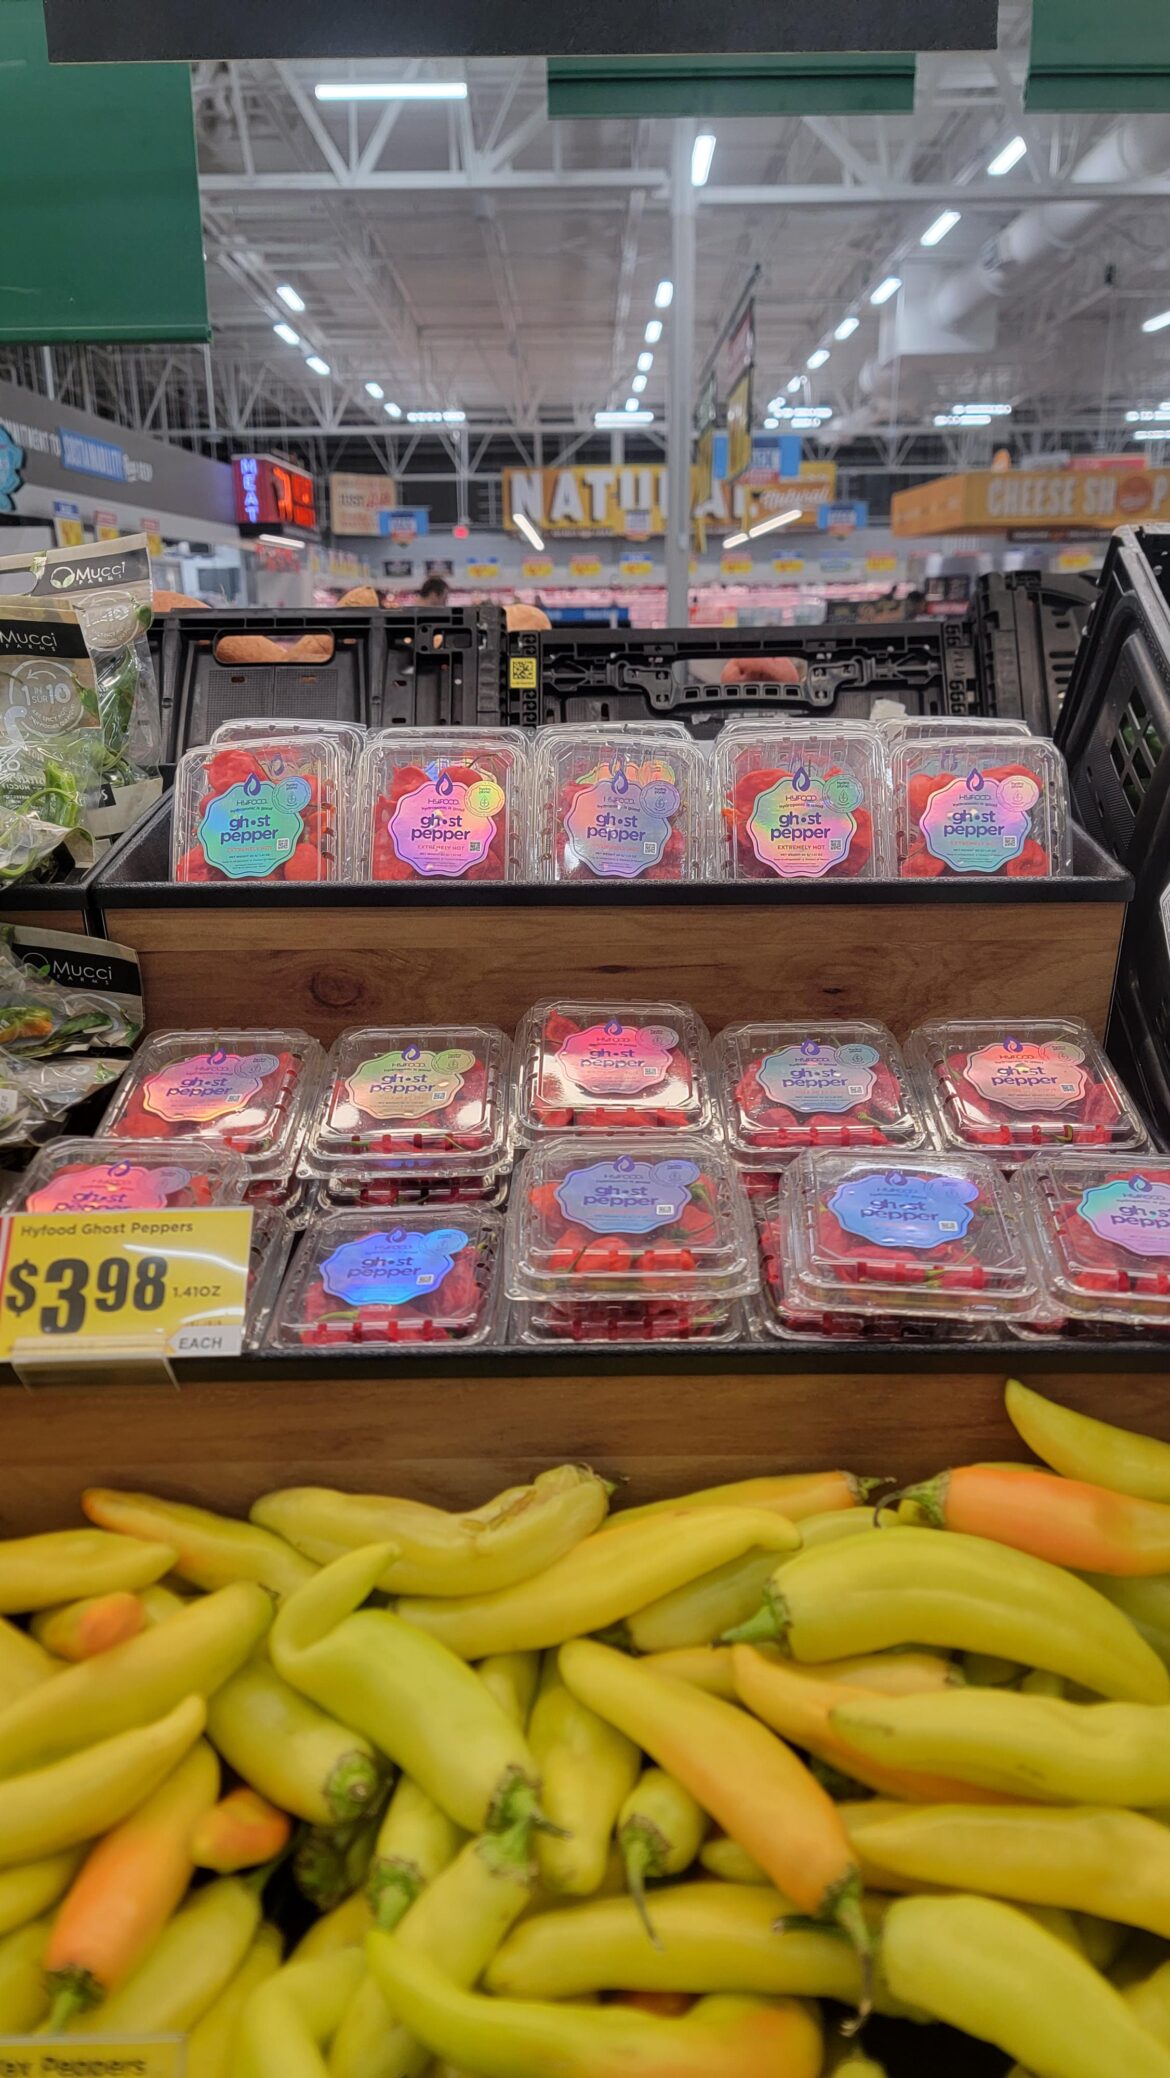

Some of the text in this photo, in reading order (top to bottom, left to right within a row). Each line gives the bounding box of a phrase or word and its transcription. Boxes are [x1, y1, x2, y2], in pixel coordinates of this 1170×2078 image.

[240, 457, 258, 523] MEAT
[988, 477, 1075, 516] CHEESE
[76, 561, 125, 580] Mucci
[0, 630, 57, 647] Mucci
[32, 695, 48, 704] SUR
[46, 683, 71, 704] 10
[220, 828, 278, 845] pepper
[412, 828, 470, 842] pepper
[587, 826, 646, 842] pepper
[771, 828, 830, 841] pepper
[944, 825, 1004, 838] pepper
[53, 960, 112, 980] Mucci
[580, 1058, 646, 1068] pepper
[782, 1078, 848, 1088] pepper
[991, 1076, 1058, 1086] pepper
[166, 1086, 232, 1097] pepper
[370, 1084, 436, 1094] pepper
[583, 1196, 658, 1207] pepper
[860, 1208, 939, 1221] pepper
[21, 1222, 193, 1236] Hyfood Ghost Peppers
[348, 1268, 421, 1278] pepper
[172, 1286, 221, 1298] 1.41OZ
[178, 1337, 222, 1350] EACH
